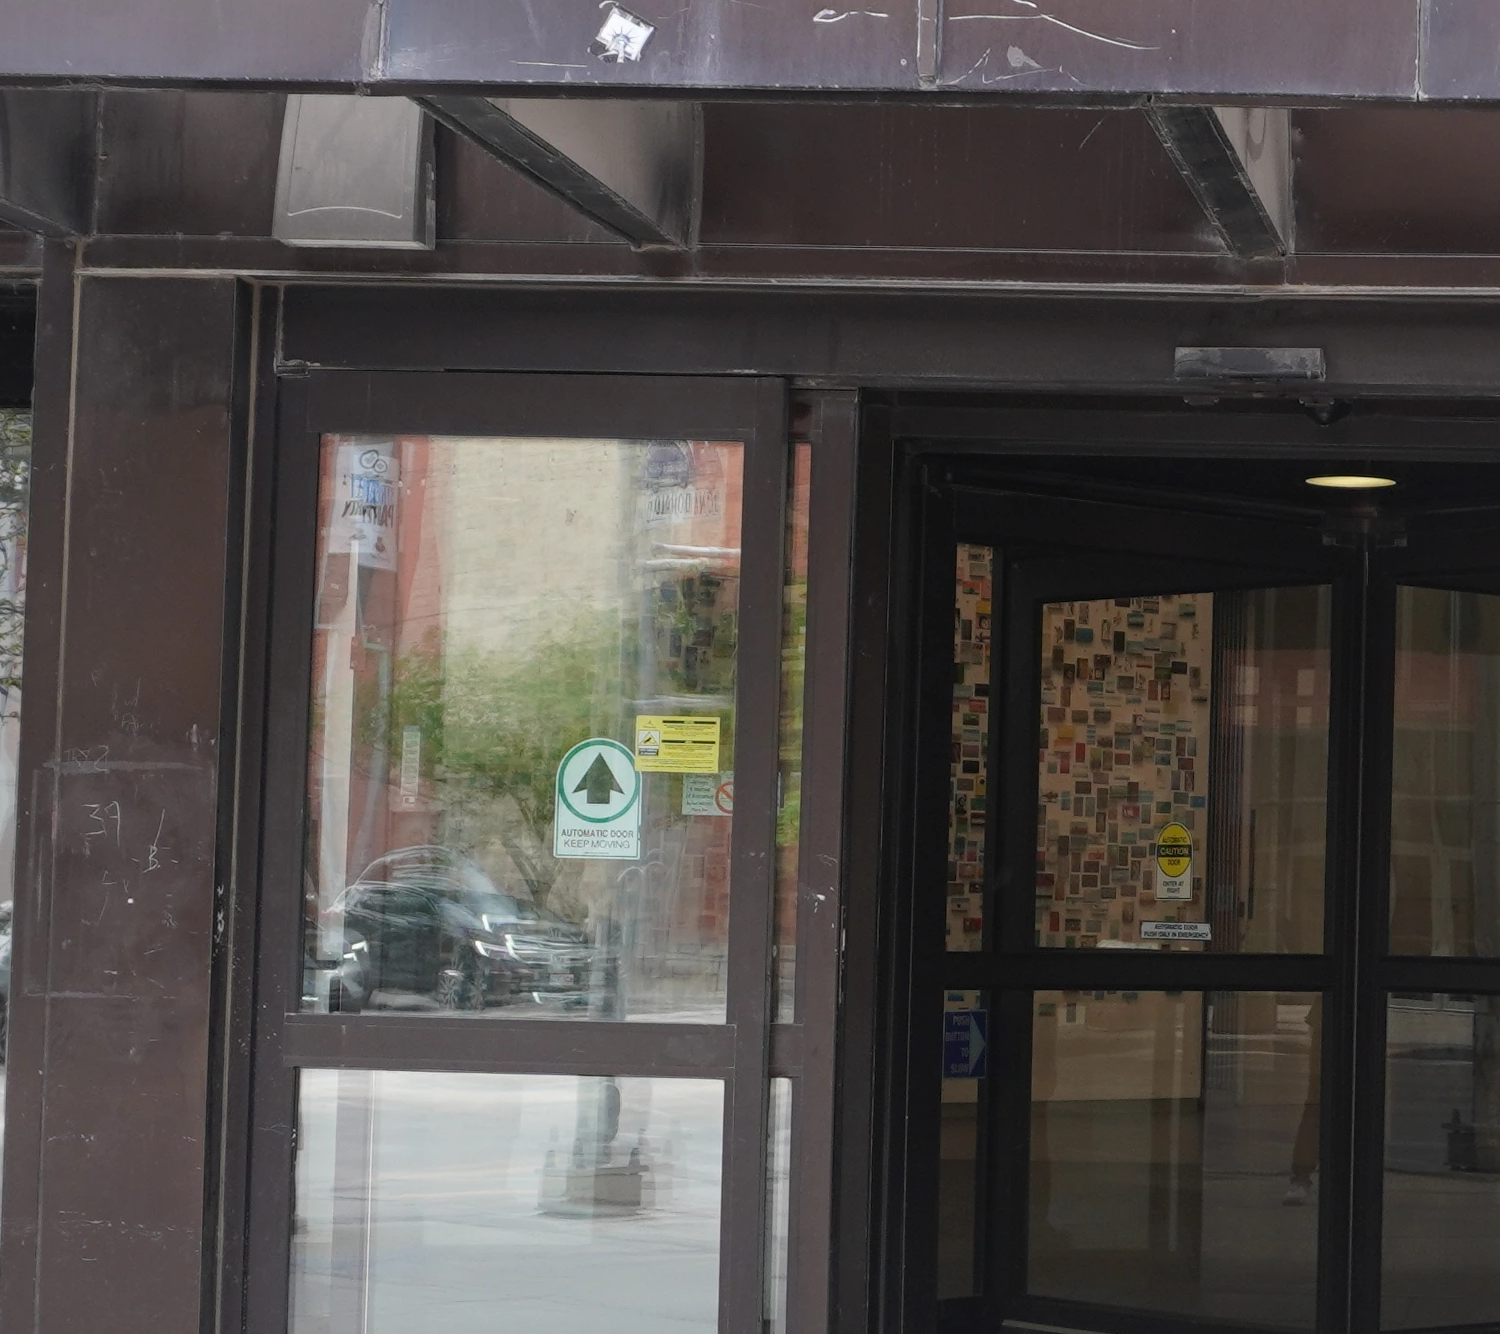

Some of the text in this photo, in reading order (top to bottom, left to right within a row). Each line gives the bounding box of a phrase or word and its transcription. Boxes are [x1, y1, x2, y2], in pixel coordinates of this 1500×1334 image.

[561, 829, 634, 838] AUTOMATIC DOOR
[563, 839, 630, 849] KEEP MOVING
[1159, 847, 1189, 856] CAUTION
